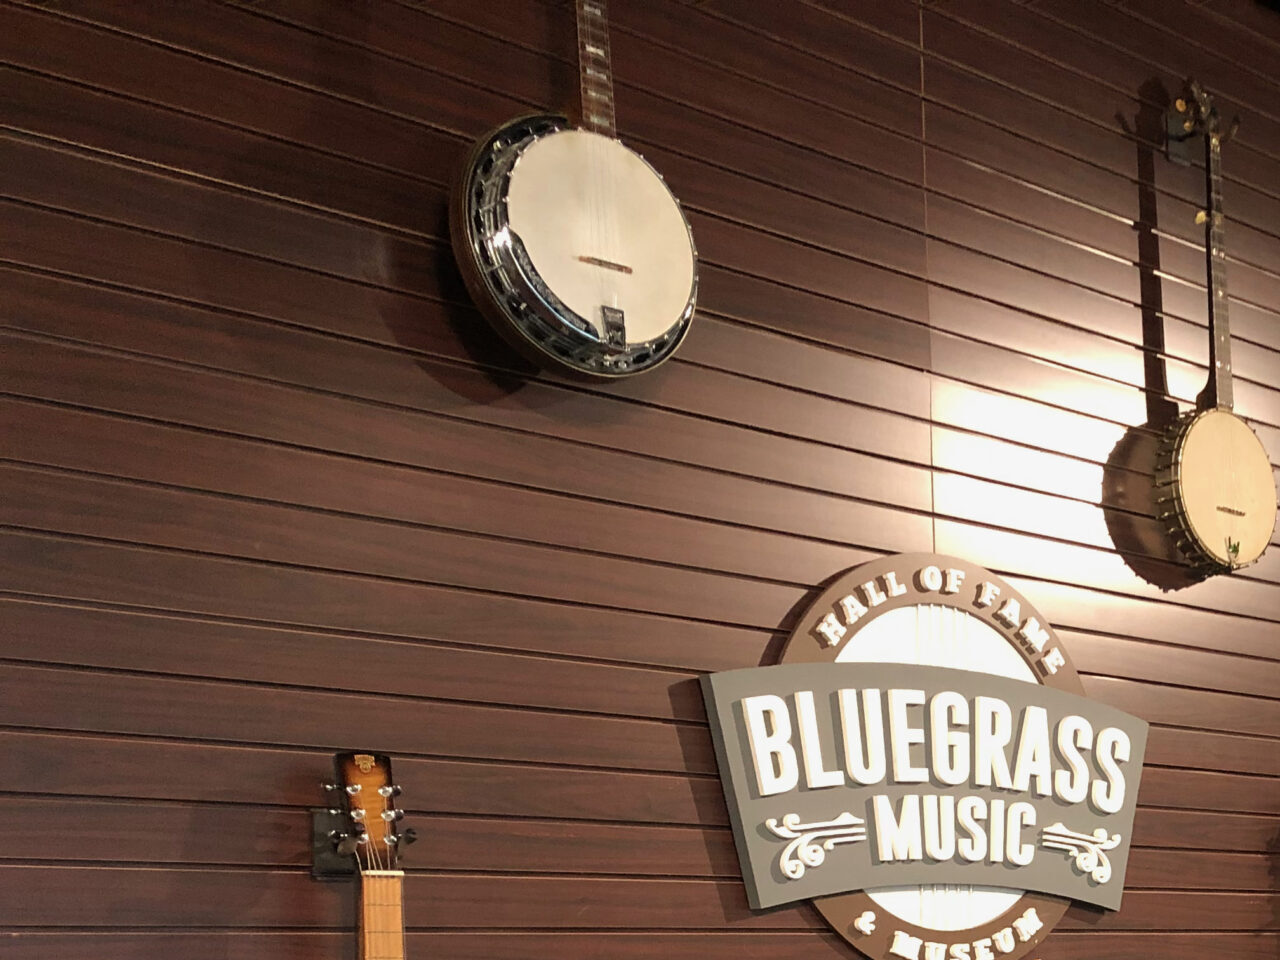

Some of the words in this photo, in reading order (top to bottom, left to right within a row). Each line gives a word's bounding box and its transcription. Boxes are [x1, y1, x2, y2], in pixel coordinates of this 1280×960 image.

[815, 571, 907, 647] HALL
[917, 565, 966, 595] OF
[979, 581, 1066, 676] FAME
[741, 687, 1132, 814] BLUEGRASS
[872, 794, 1037, 867] MUSIC
[853, 910, 877, 936] &
